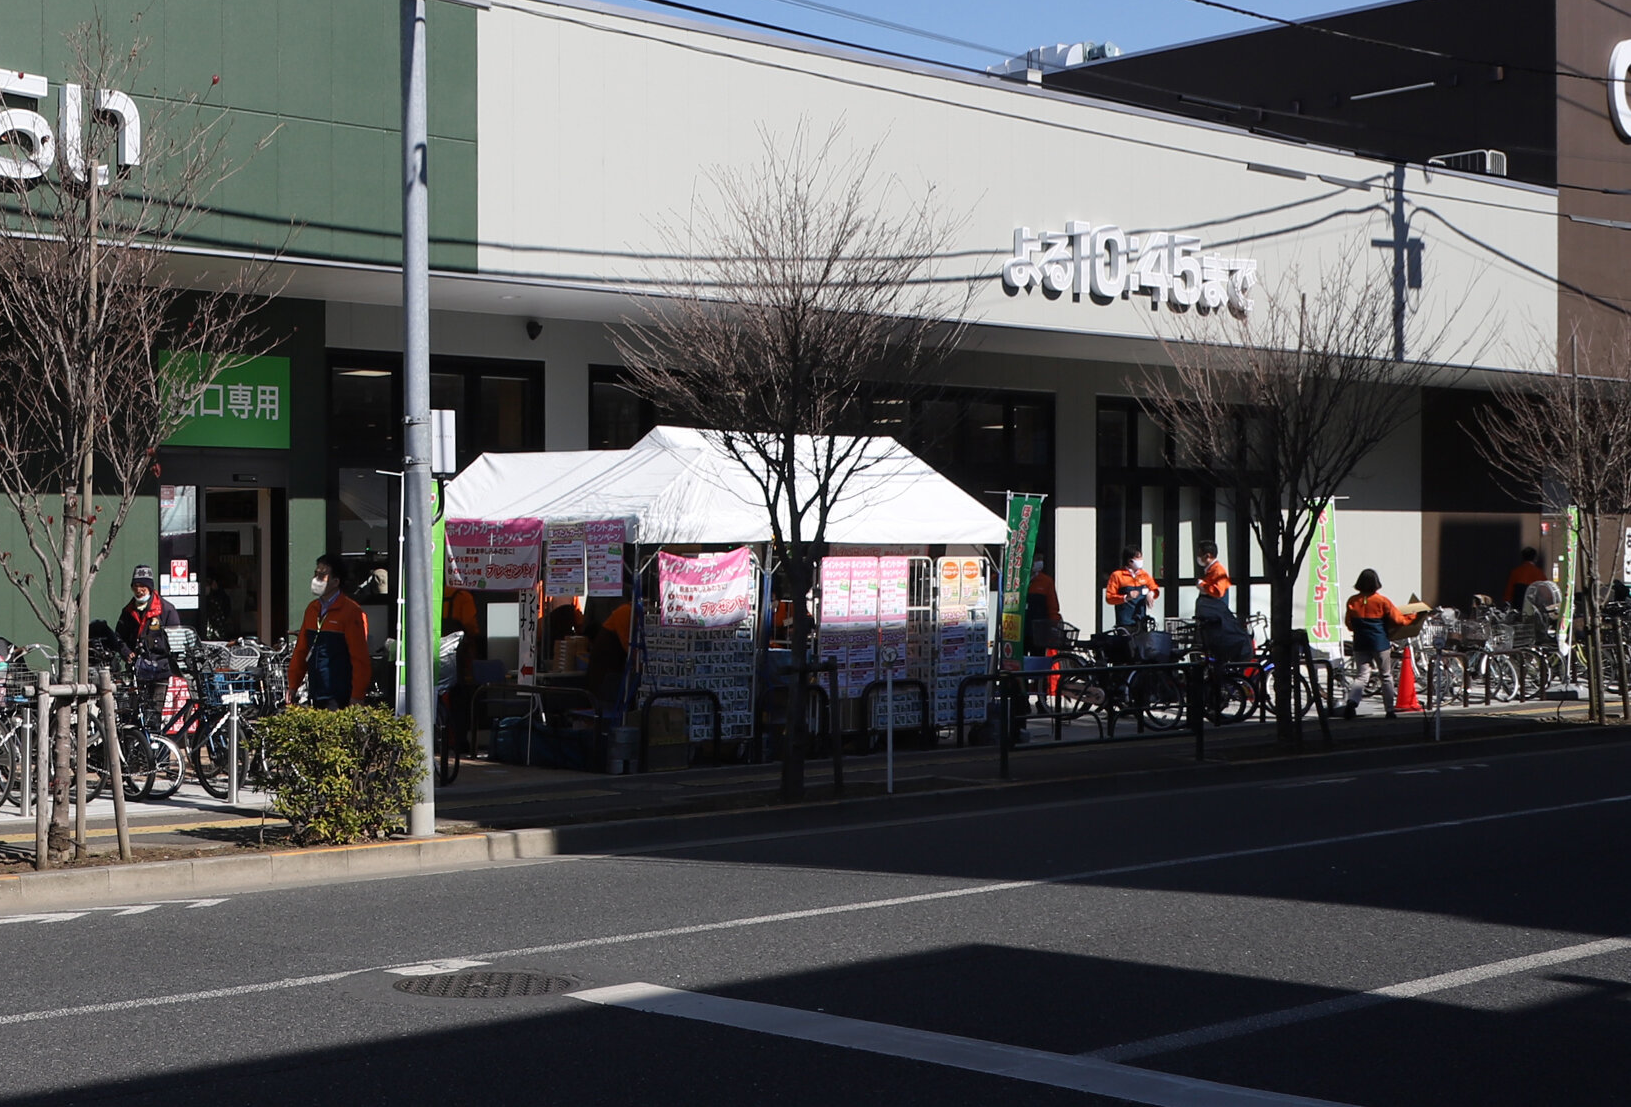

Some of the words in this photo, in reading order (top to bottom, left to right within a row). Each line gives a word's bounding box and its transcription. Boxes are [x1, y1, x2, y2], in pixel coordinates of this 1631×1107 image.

[1003, 220, 1258, 313] よる10:45まで
[447, 521, 504, 537] ポイントカード
[487, 529, 541, 545] キャンペーン
